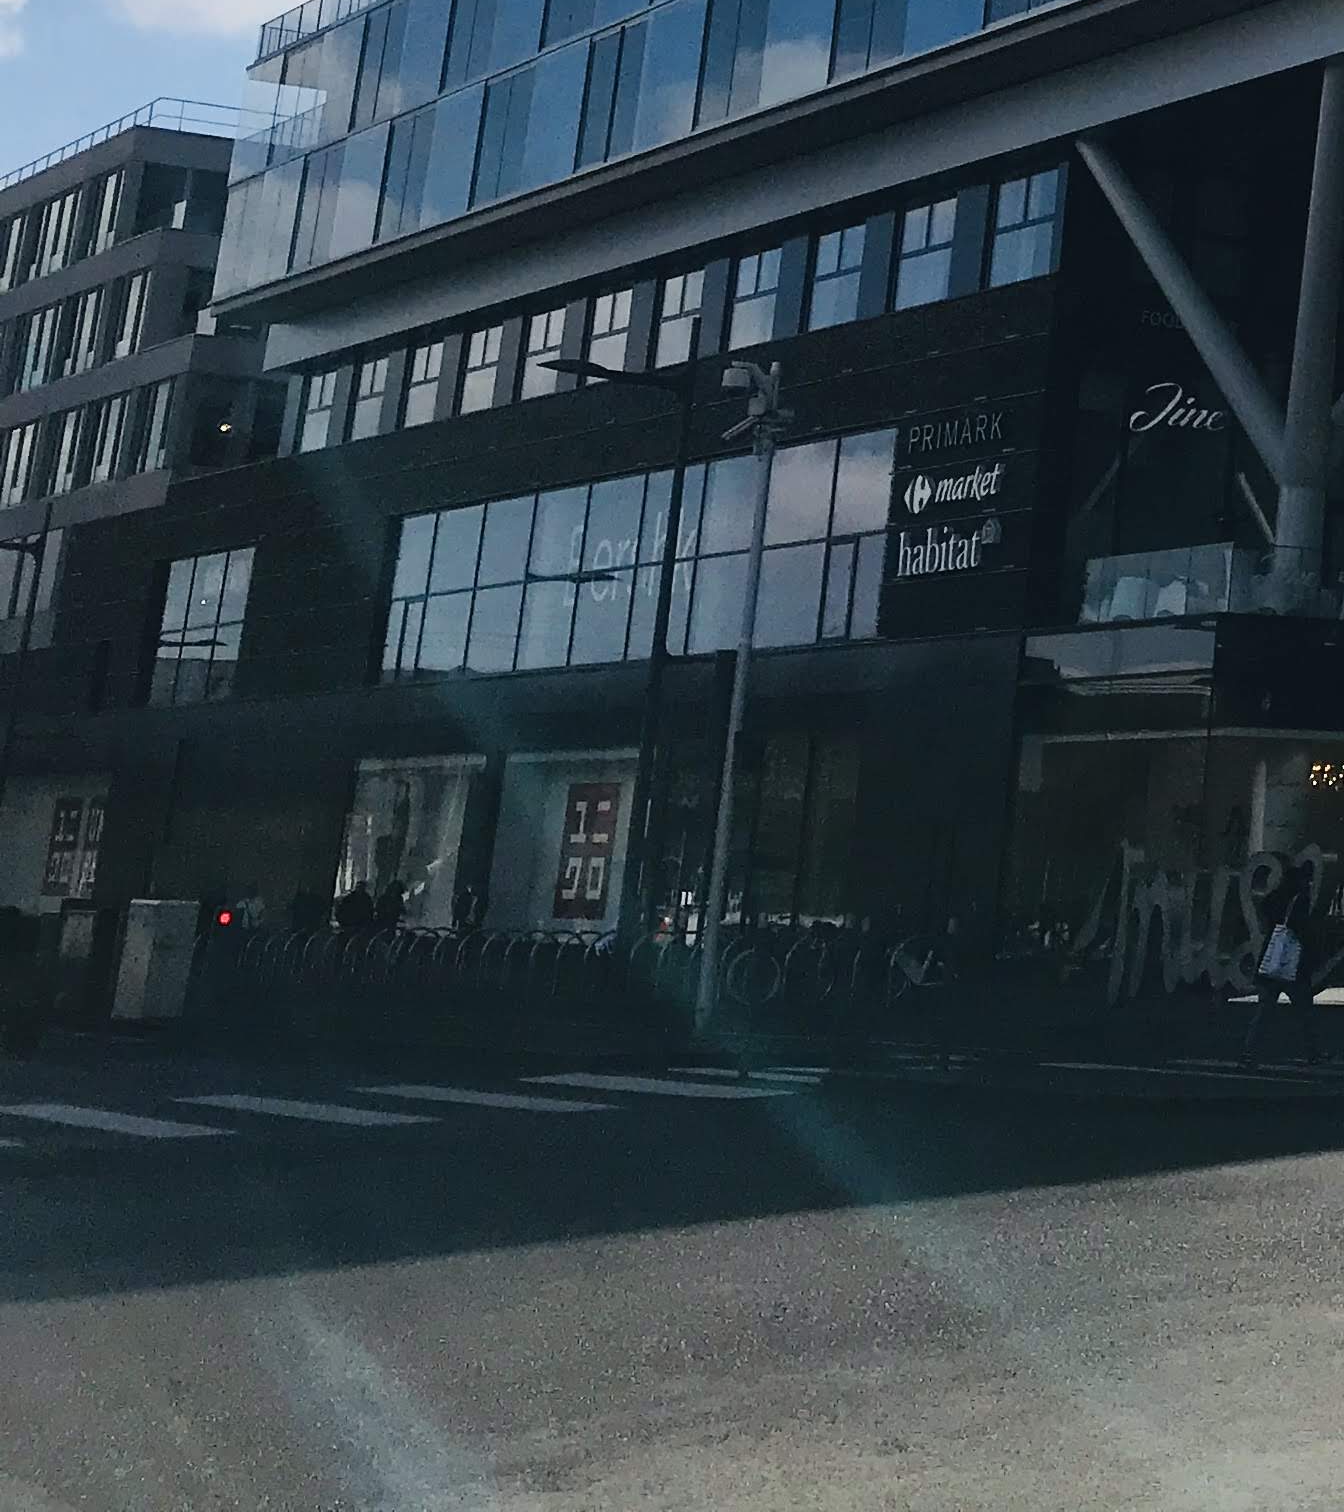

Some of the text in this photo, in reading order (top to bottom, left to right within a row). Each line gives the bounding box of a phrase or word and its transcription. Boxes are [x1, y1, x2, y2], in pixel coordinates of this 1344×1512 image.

[908, 411, 1005, 454] PRIMARK
[935, 462, 1003, 503] market
[897, 526, 981, 577] habitat
